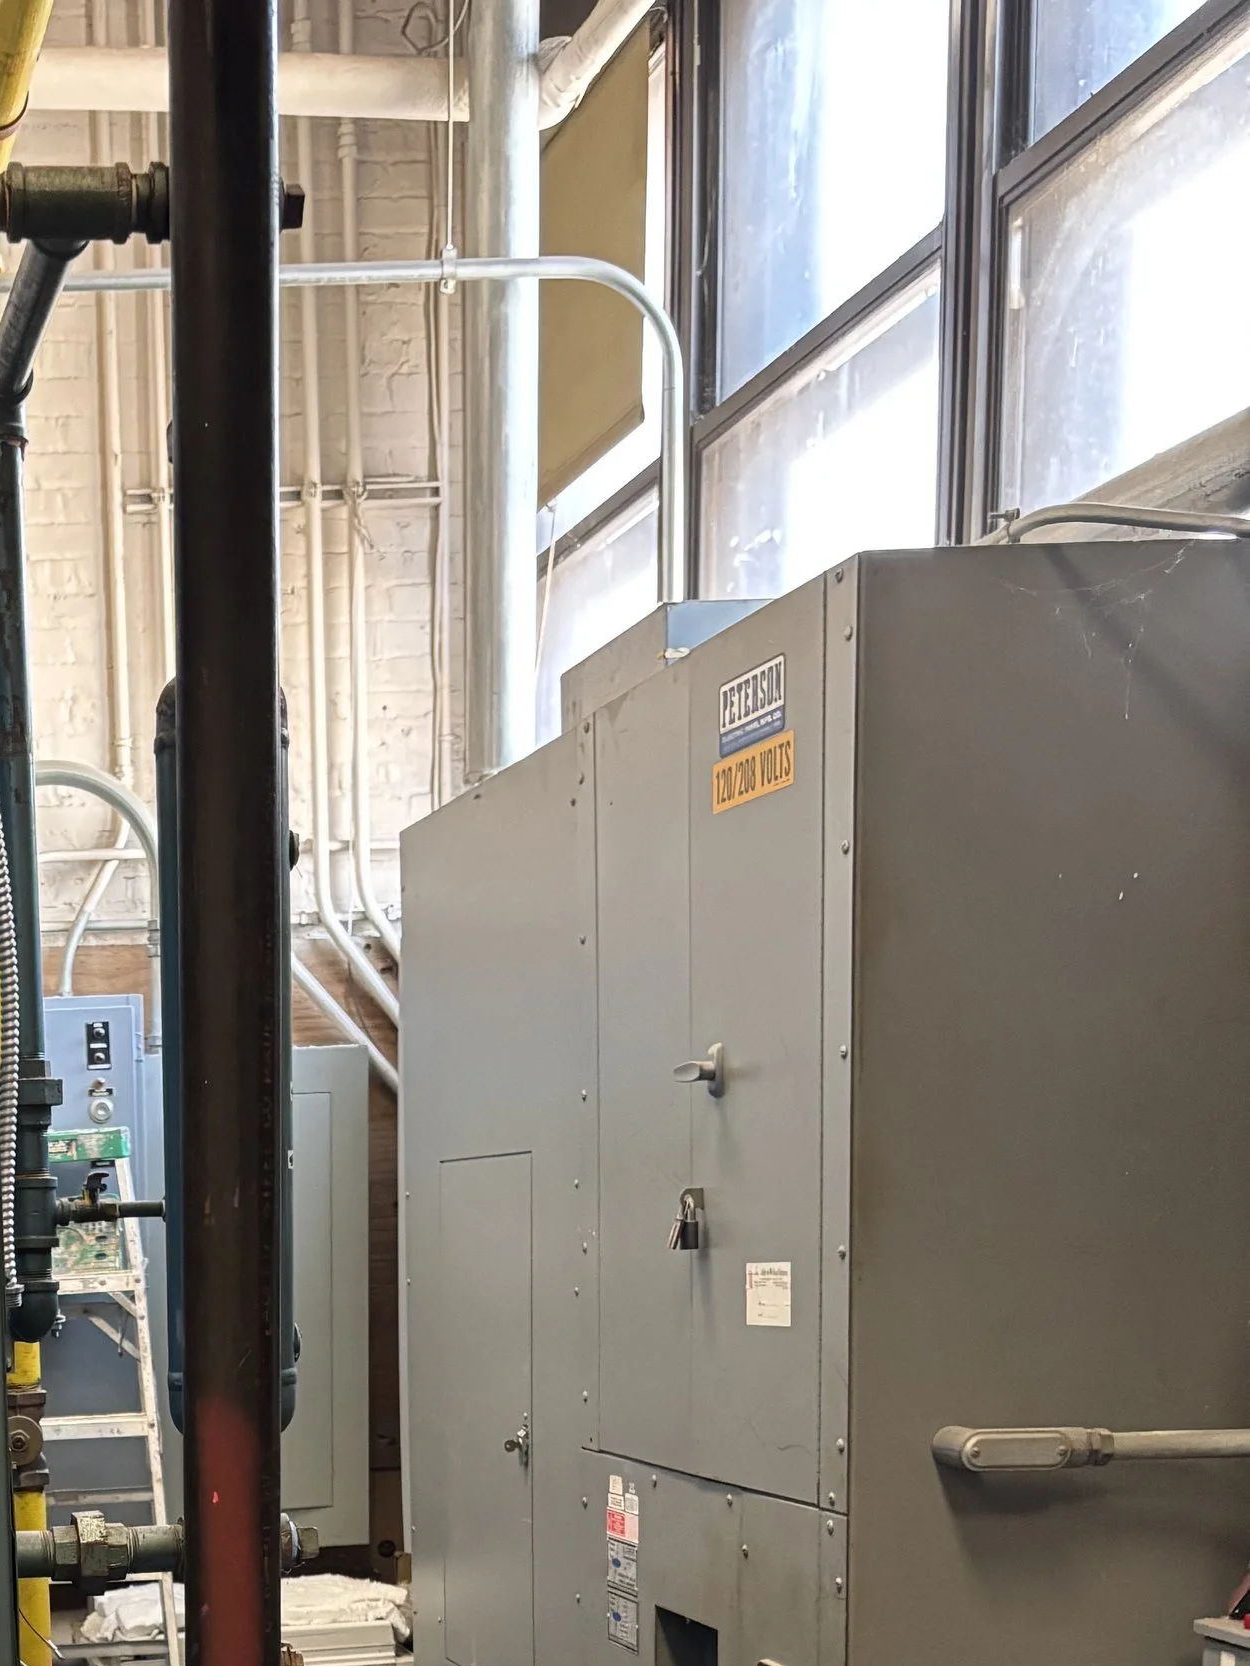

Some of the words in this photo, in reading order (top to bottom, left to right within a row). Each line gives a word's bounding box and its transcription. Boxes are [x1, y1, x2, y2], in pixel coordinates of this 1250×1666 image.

[721, 661, 782, 728] PETERSON
[716, 756, 756, 805] 120/208
[760, 740, 791, 787] VOLTS
